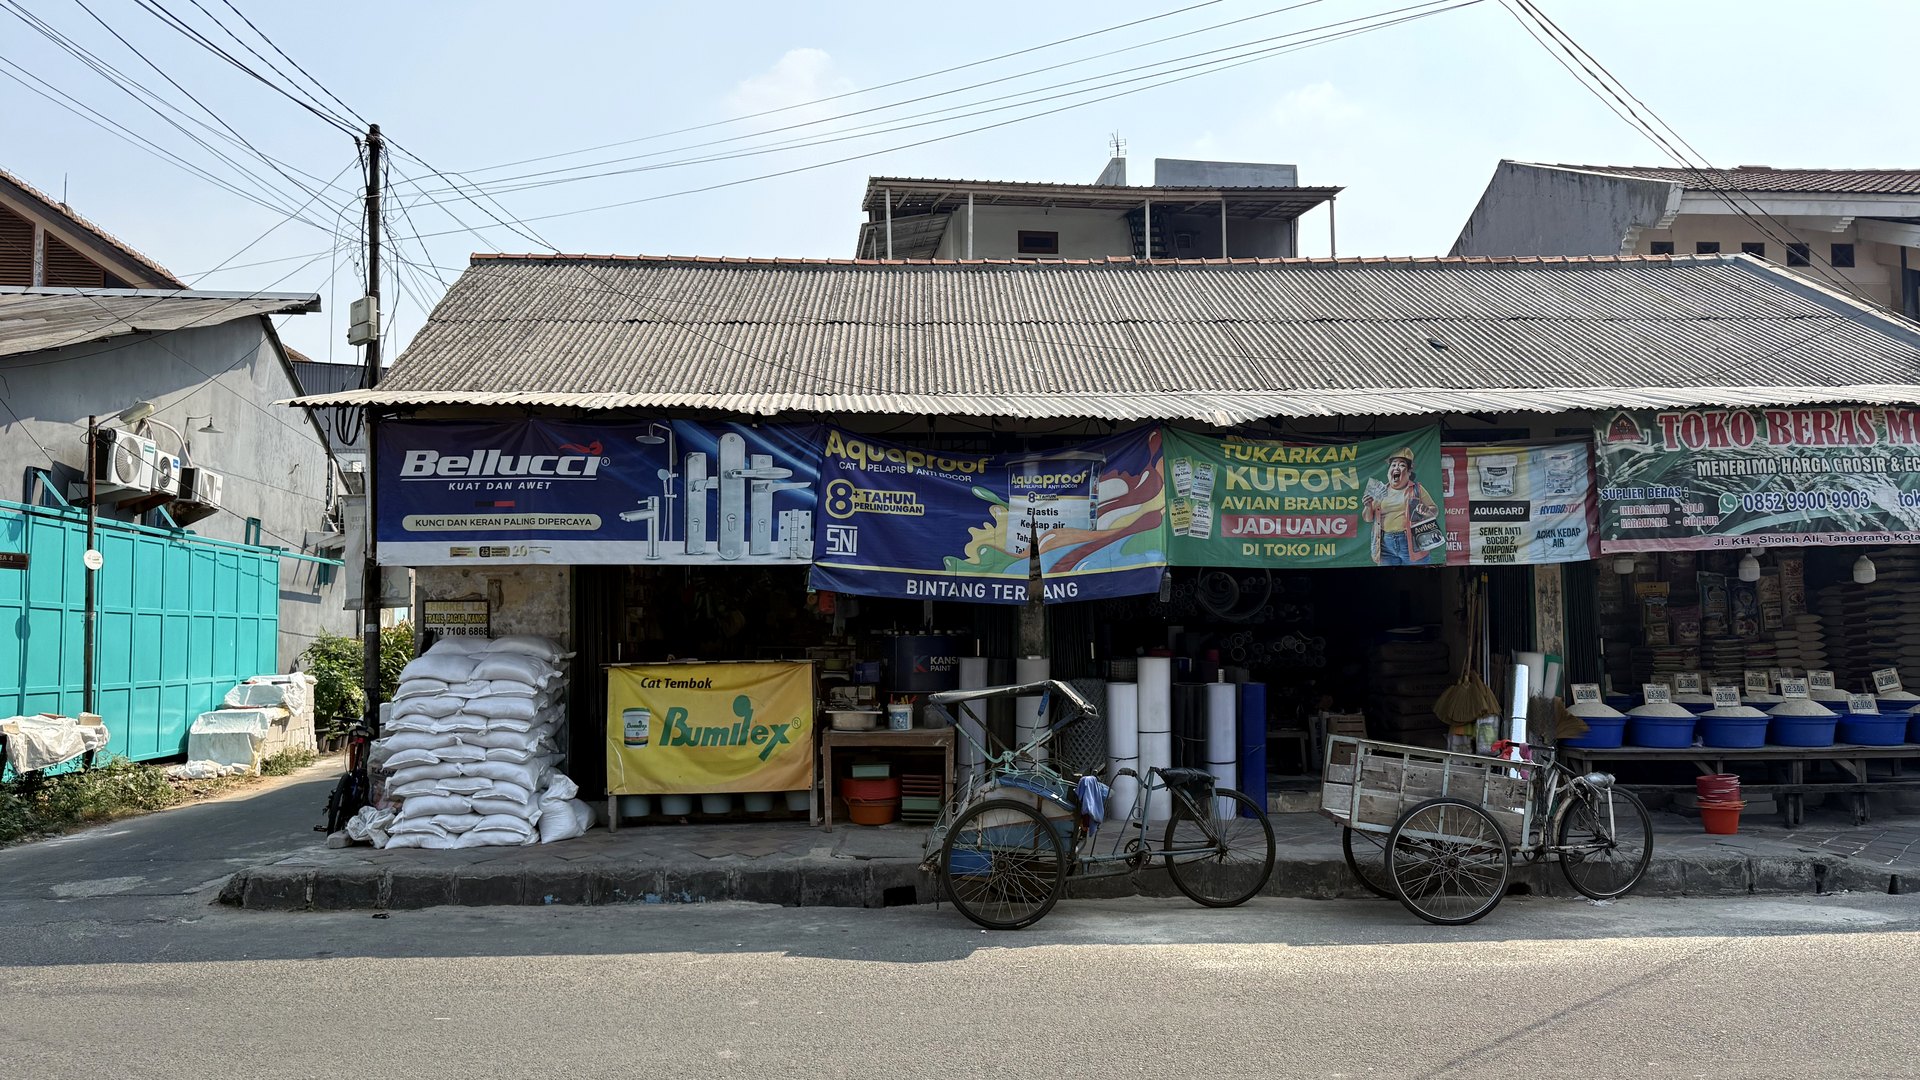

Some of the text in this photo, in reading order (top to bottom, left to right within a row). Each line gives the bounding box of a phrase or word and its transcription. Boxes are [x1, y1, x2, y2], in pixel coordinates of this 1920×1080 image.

[1658, 410, 1755, 450] TOKO
[1765, 409, 1876, 446] BERAS
[825, 430, 989, 474] Aquaproof
[1221, 444, 1358, 463] TUKARKAN
[400, 449, 601, 477] Bellucci
[1697, 457, 1777, 476] MENERIMA
[1781, 457, 1831, 473] HARGA
[1833, 457, 1886, 473] GROSIR
[1890, 458, 1901, 471] &
[839, 461, 972, 482] CAT PELAPIS ANTI BOCOR
[1011, 471, 1087, 488] Aquaproof
[1226, 465, 1359, 492] KUPON
[449, 481, 551, 490] KUAT DAN AWET
[863, 491, 914, 505] TAHUN
[1601, 487, 1644, 500] SUPLIER
[1648, 486, 1682, 498] BERAS
[1221, 496, 1358, 510] AVIAN BRANDS
[1743, 494, 1783, 511] 0852
[1787, 492, 1827, 510] 9900
[1832, 490, 1870, 508] 9903
[854, 502, 923, 514] PERLINDUNGAN
[1027, 508, 1059, 516] Elastis
[1473, 507, 1525, 516] AQUAGARD
[1682, 503, 1704, 513] SOLO
[415, 517, 592, 527] KUNCI DAN KERAN PALING DIPERCAYA
[1052, 521, 1065, 529] air
[1232, 518, 1348, 534] JADI UANG
[1682, 516, 1719, 526] CIANJUR
[1479, 527, 1522, 535] SEMEN ANTI
[826, 528, 858, 552] SNI
[1486, 536, 1515, 544] BOCOR 2
[1552, 538, 1565, 548] AIR
[1731, 537, 1755, 546] KH.
[1759, 535, 1799, 544] Sholeh
[1802, 534, 1823, 544] Ali,
[1826, 533, 1891, 543] Tangerang
[1242, 543, 1336, 556] DI TOKO INI
[1446, 541, 1462, 551] MEN
[1482, 545, 1518, 553] KOMPONEN
[1484, 555, 1516, 563] PREMIUM
[906, 579, 986, 598] BINTANG
[446, 627, 467, 635] 7108
[469, 627, 488, 635] 6868
[930, 656, 959, 665] KANSA
[640, 677, 713, 689] Cat Tembok
